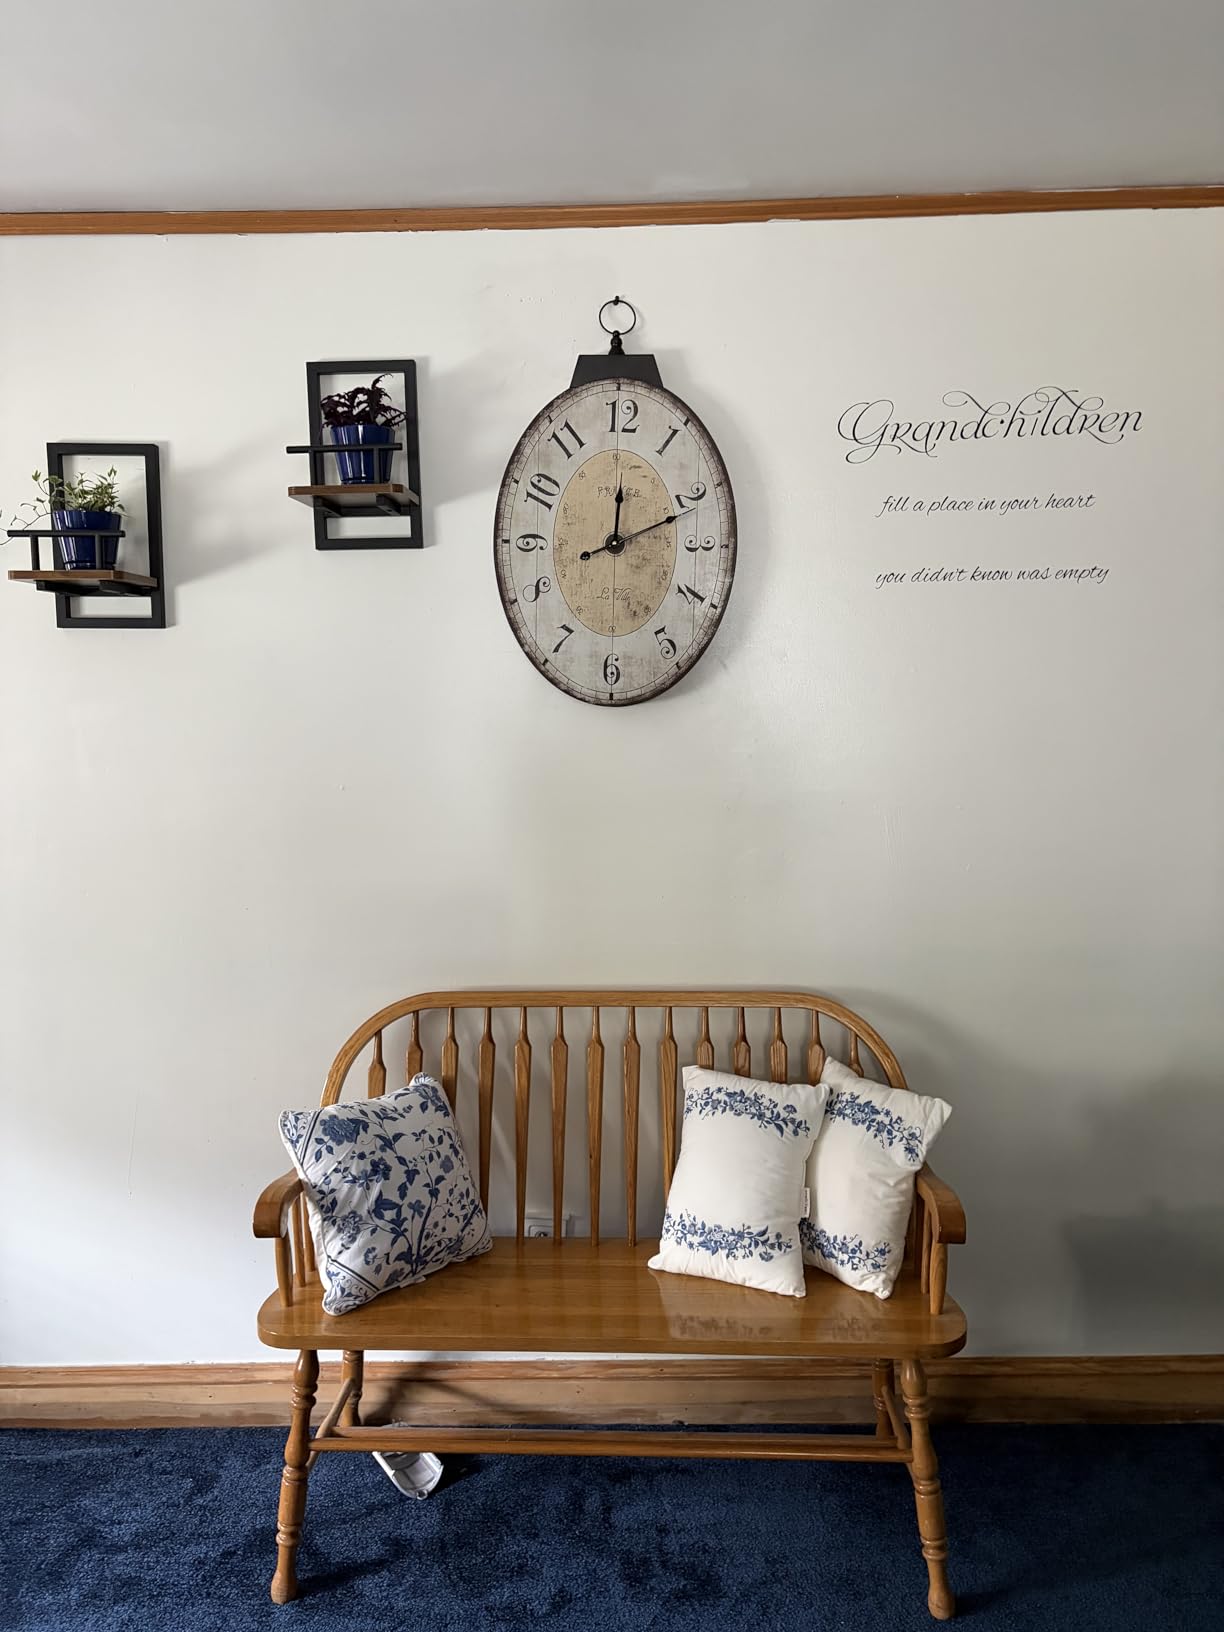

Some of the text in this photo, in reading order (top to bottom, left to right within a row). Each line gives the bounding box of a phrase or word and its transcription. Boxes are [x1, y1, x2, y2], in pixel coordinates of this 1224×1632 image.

[605, 399, 640, 434] 12
[837, 386, 1142, 464] Grandchildren
[547, 419, 587, 460] 11
[655, 425, 681, 456] 1
[523, 472, 561, 512] 10
[676, 481, 707, 510] 2
[875, 493, 1096, 518] fill a place in your heart
[515, 533, 548, 553] 9
[684, 535, 716, 553] 3
[522, 576, 552, 603] 8
[875, 566, 1109, 590] you didn't know was empty
[676, 583, 707, 607] 4
[552, 623, 575, 654] 7
[653, 625, 677, 660] 5
[603, 653, 621, 685] 6
